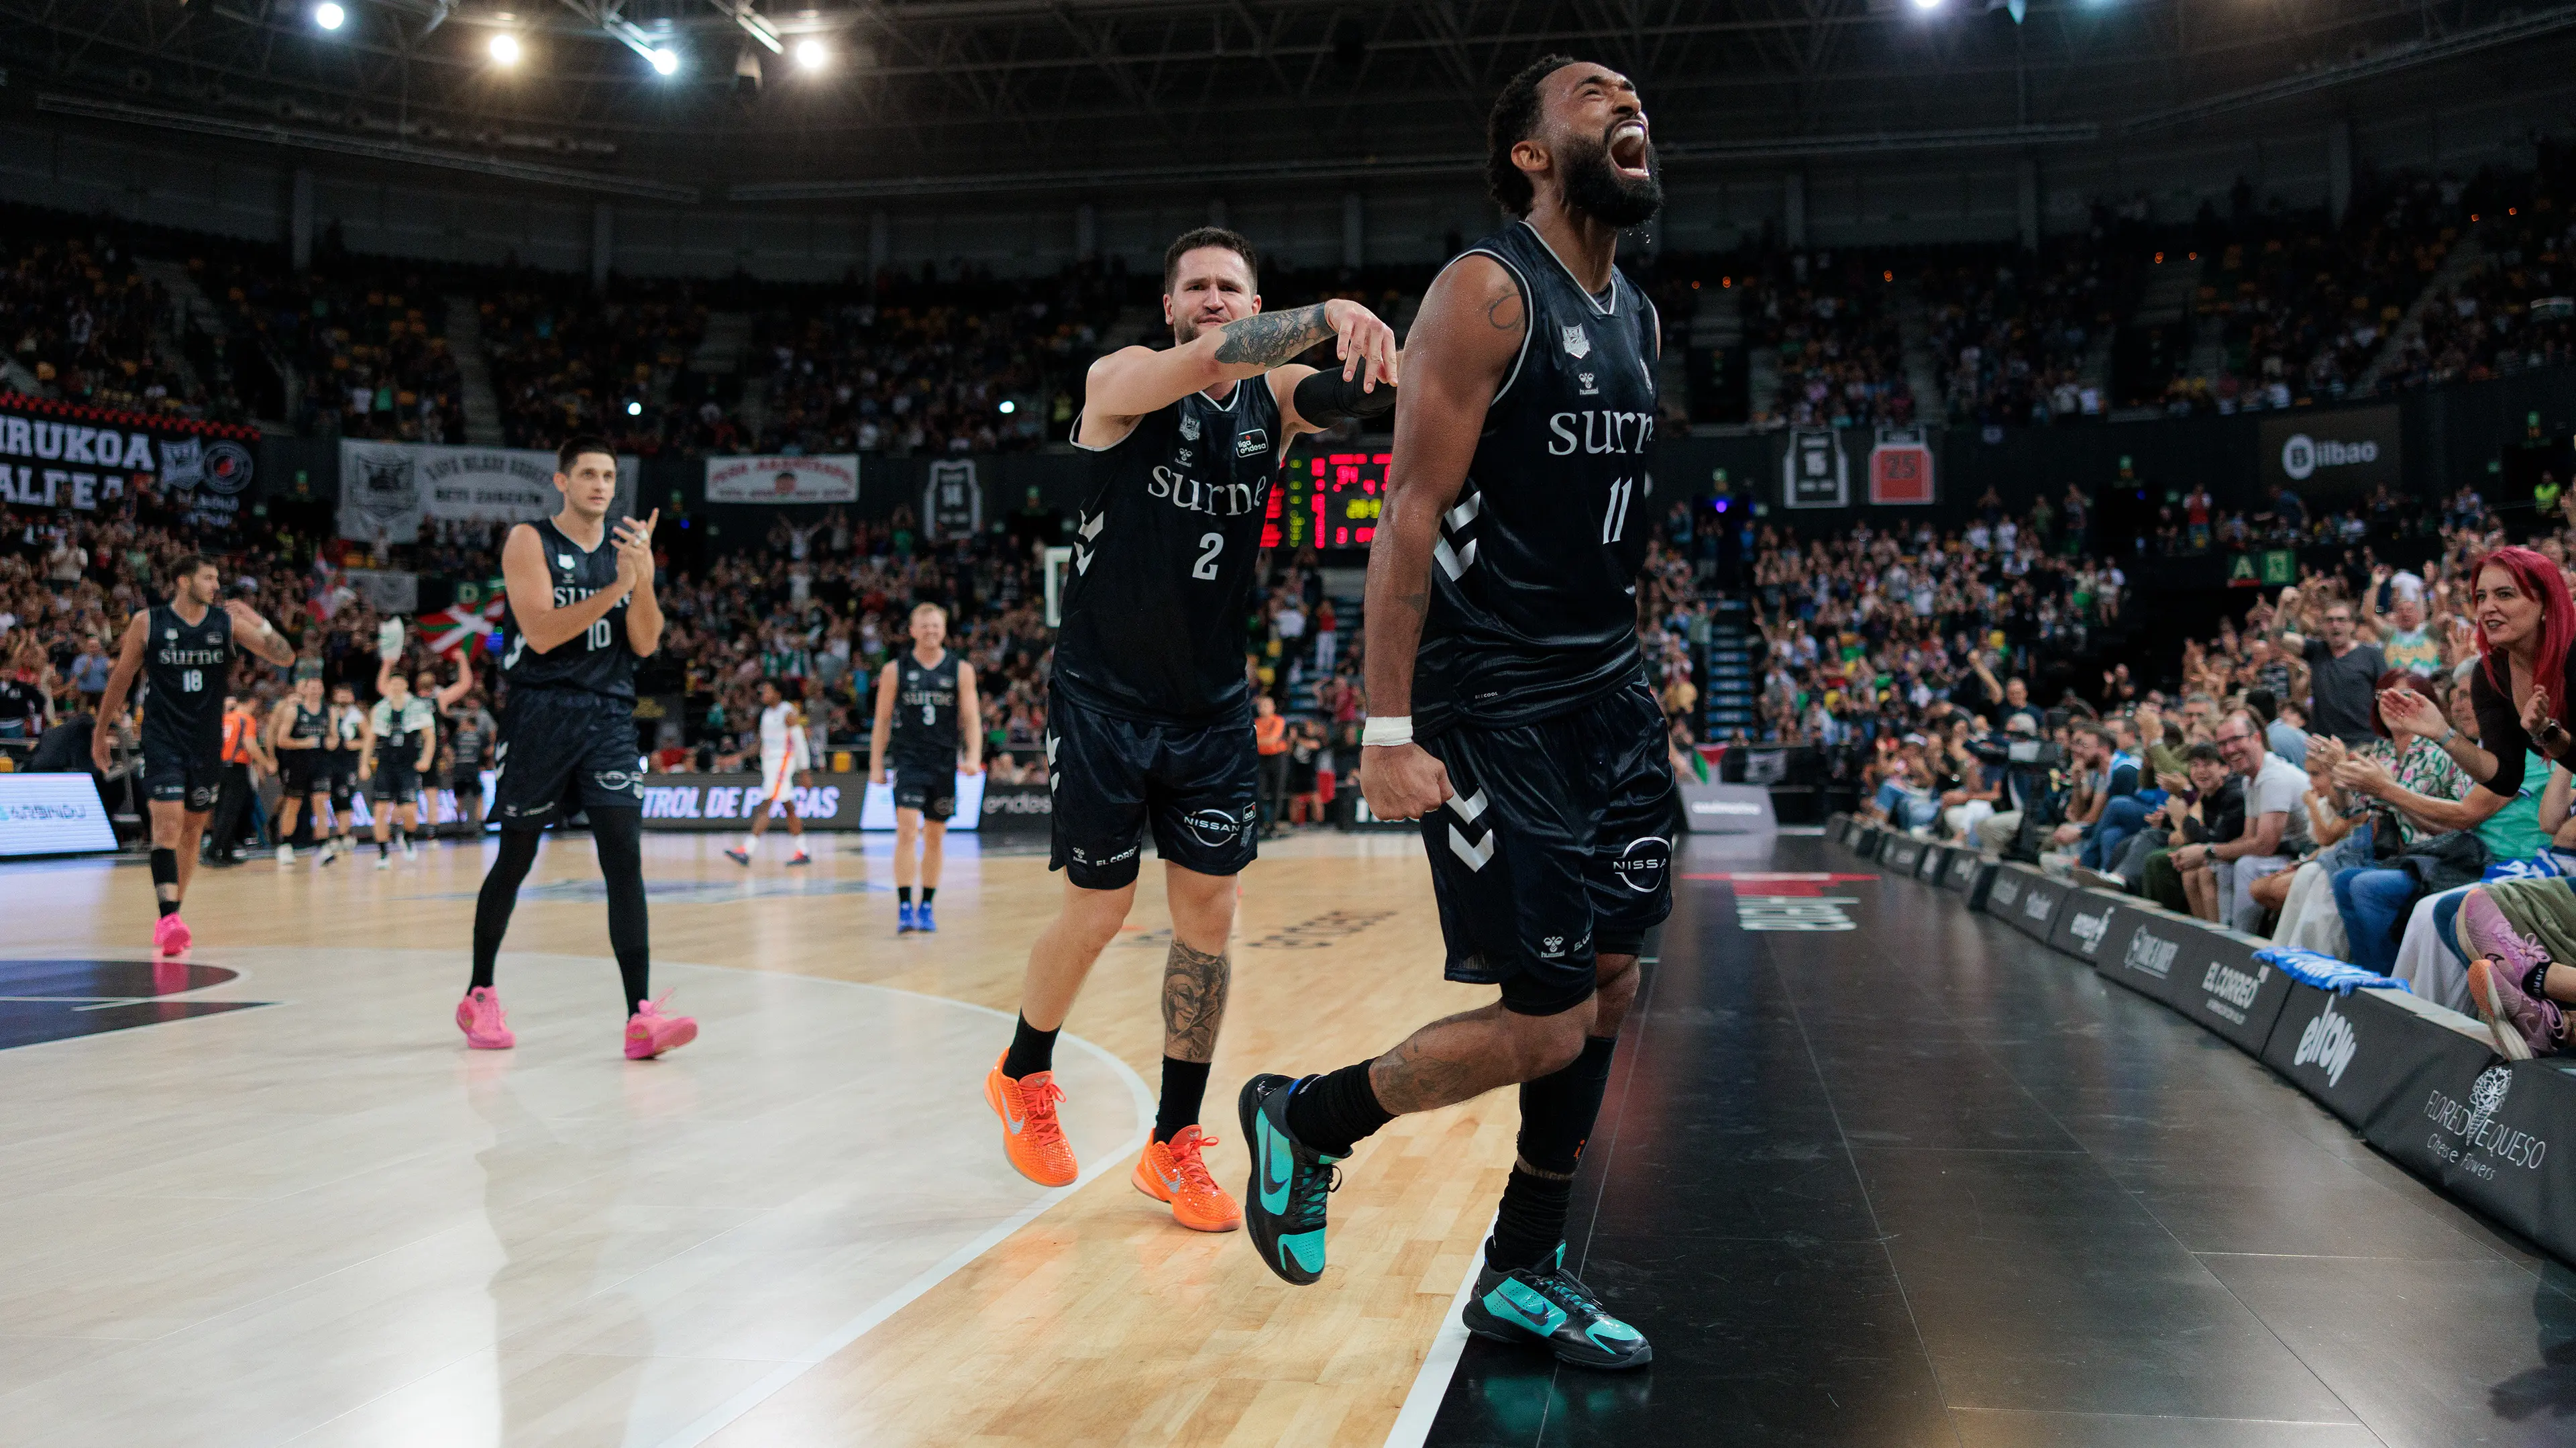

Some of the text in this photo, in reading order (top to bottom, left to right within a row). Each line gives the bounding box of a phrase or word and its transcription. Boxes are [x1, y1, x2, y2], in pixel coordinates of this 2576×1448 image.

[1237, 439, 1252, 449] liga
[1548, 410, 1656, 456] surn
[1246, 443, 1267, 454] endesa
[2282, 433, 2379, 480] Bilbao
[1148, 465, 1267, 516] surne
[1603, 476, 1633, 545] 11
[1192, 532, 1224, 580] 2
[2233, 554, 2255, 579] A
[458, 581, 480, 604] D
[586, 618, 612, 652] 10
[182, 669, 203, 692] 18
[922, 704, 936, 725] 3
[641, 786, 841, 819] TROL DE PAGAS
[983, 790, 1053, 815] endes
[1184, 816, 1240, 832] NISSAN
[1613, 858, 1666, 870] NISSA
